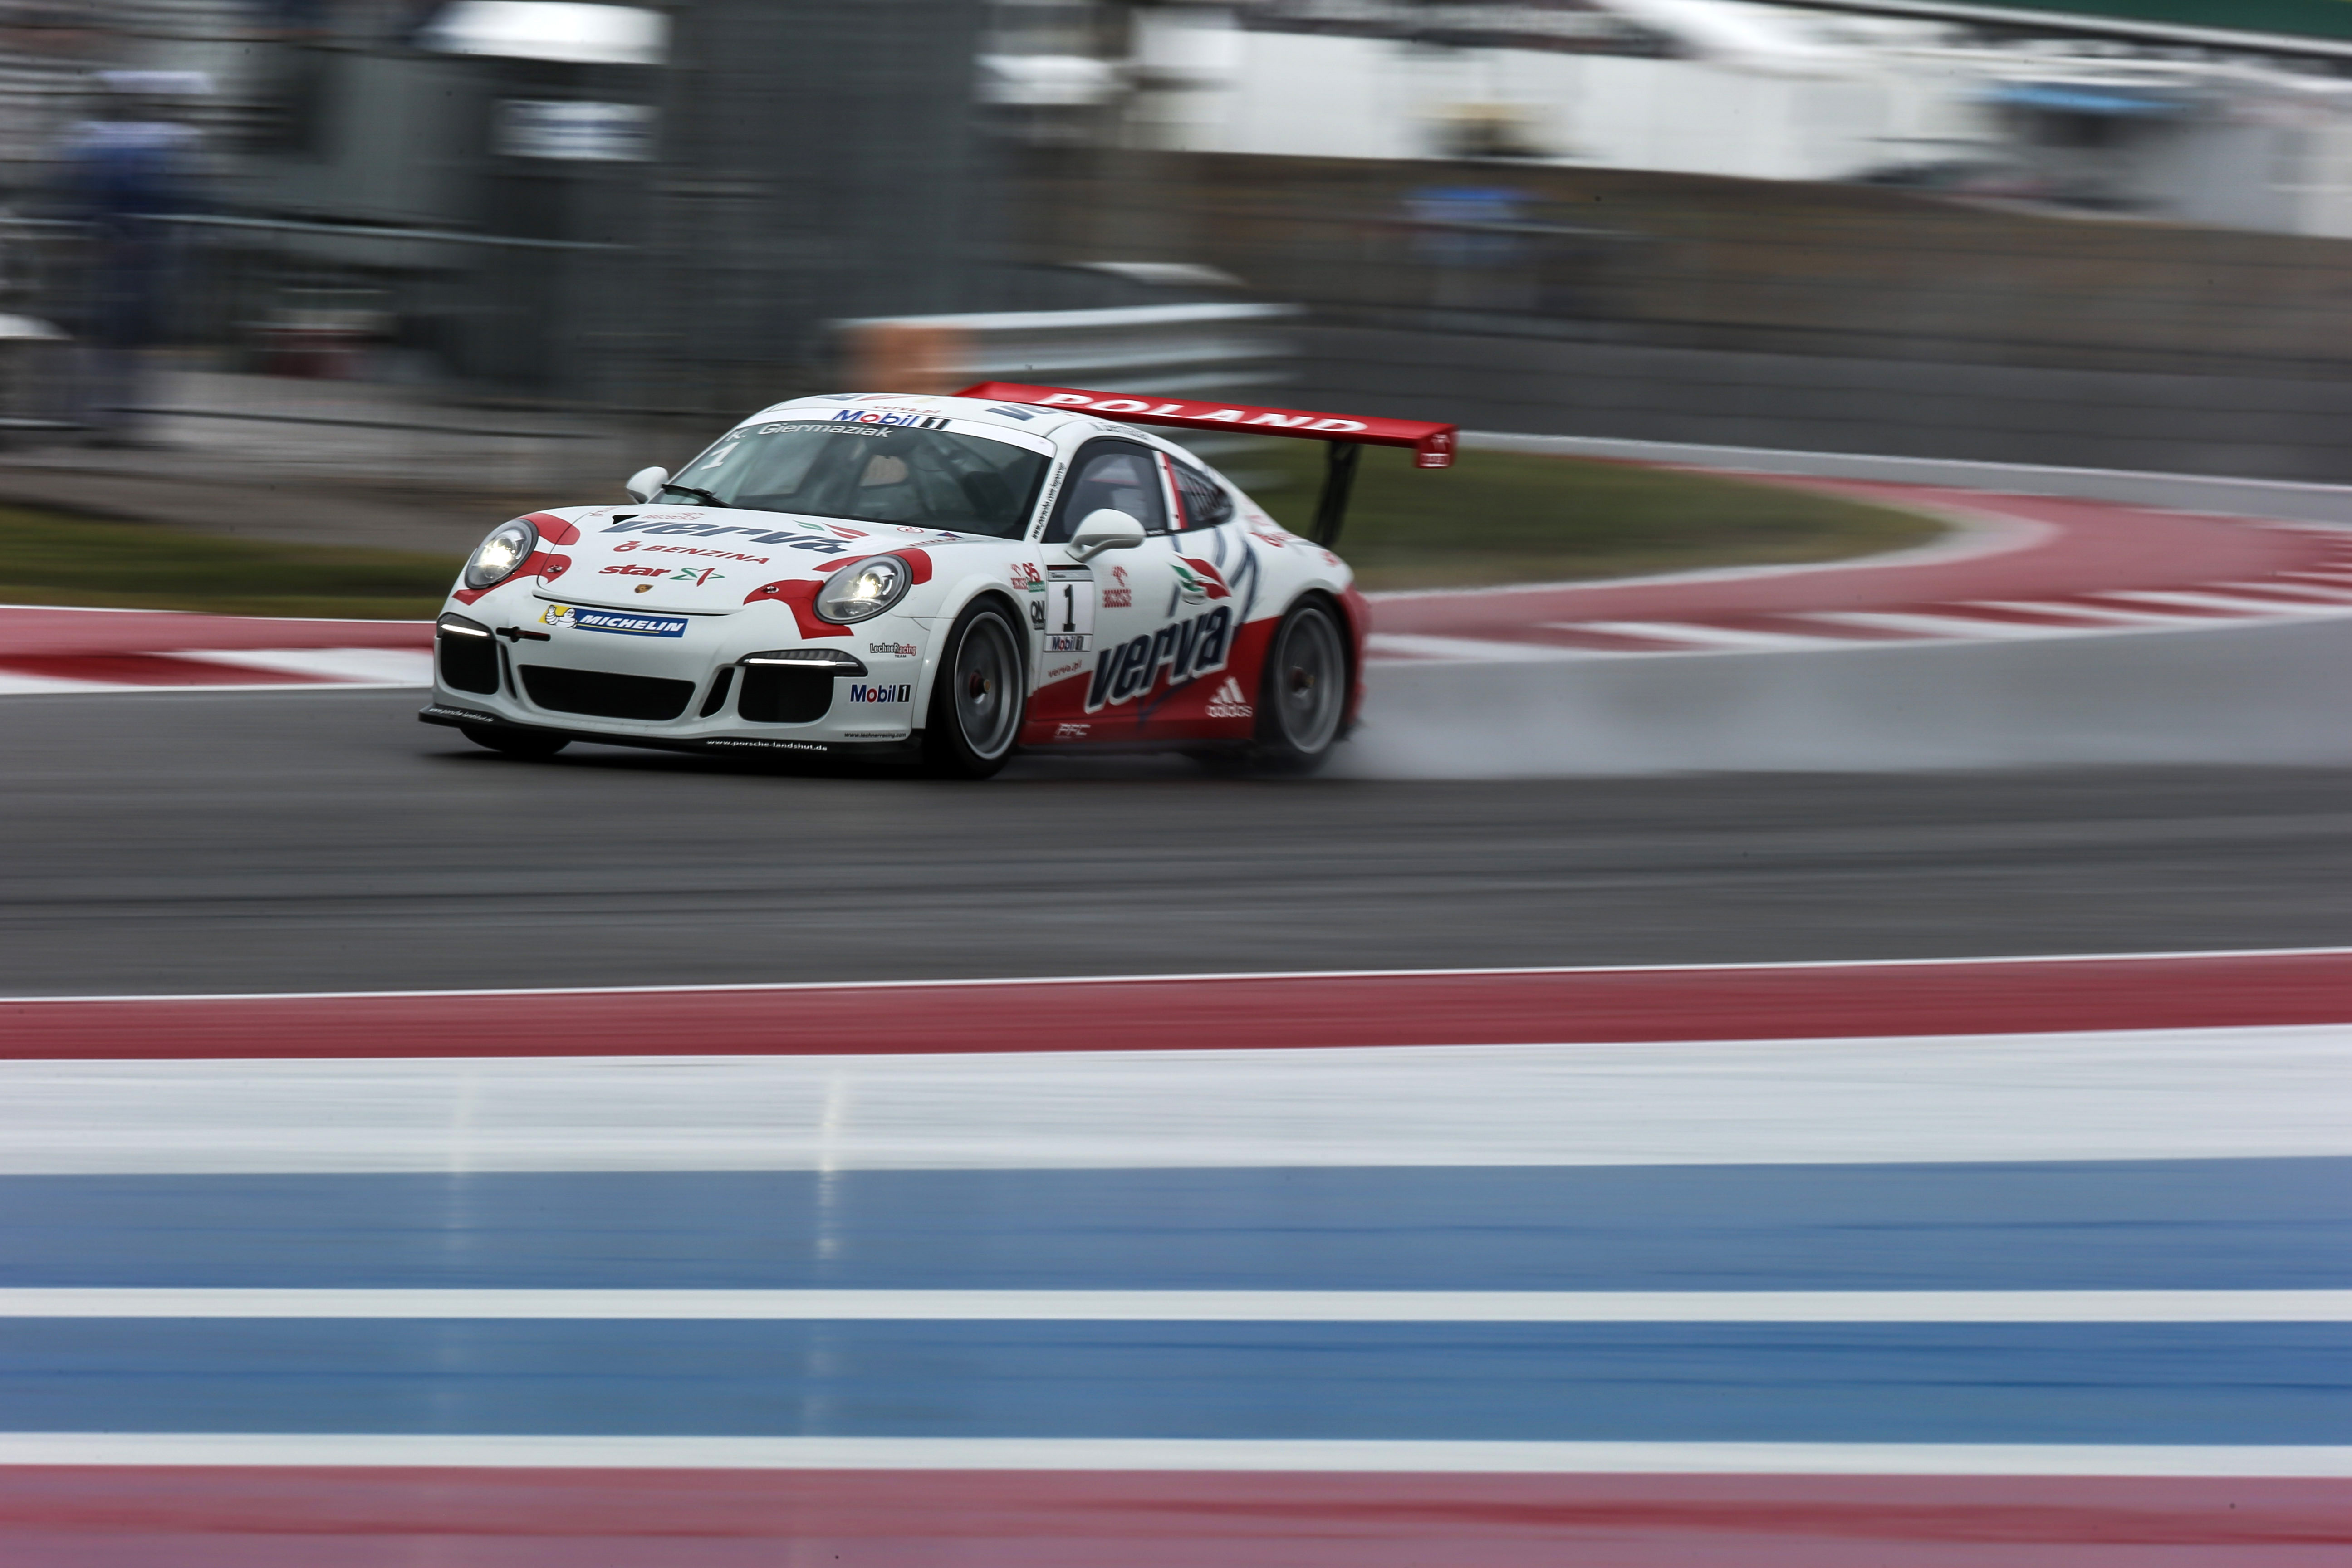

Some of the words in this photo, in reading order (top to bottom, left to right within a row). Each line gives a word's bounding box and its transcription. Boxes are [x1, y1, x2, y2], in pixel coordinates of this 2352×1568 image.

[832, 410, 920, 426] Mobil
[1030, 393, 1367, 431] POLAND
[757, 423, 893, 438] Giermaziak
[700, 441, 740, 470] 1
[598, 520, 853, 554] verva
[642, 545, 770, 564] BENZINA
[598, 564, 672, 577] star
[1023, 562, 1041, 583] 95
[1063, 584, 1076, 632] 1
[580, 615, 684, 632] MICHELIN
[1052, 636, 1074, 651] Mobil
[1085, 604, 1233, 714] verva
[850, 684, 896, 703] Mobil
[1205, 704, 1253, 717] adidas
[706, 740, 828, 751] www.porsche-landshut.de
